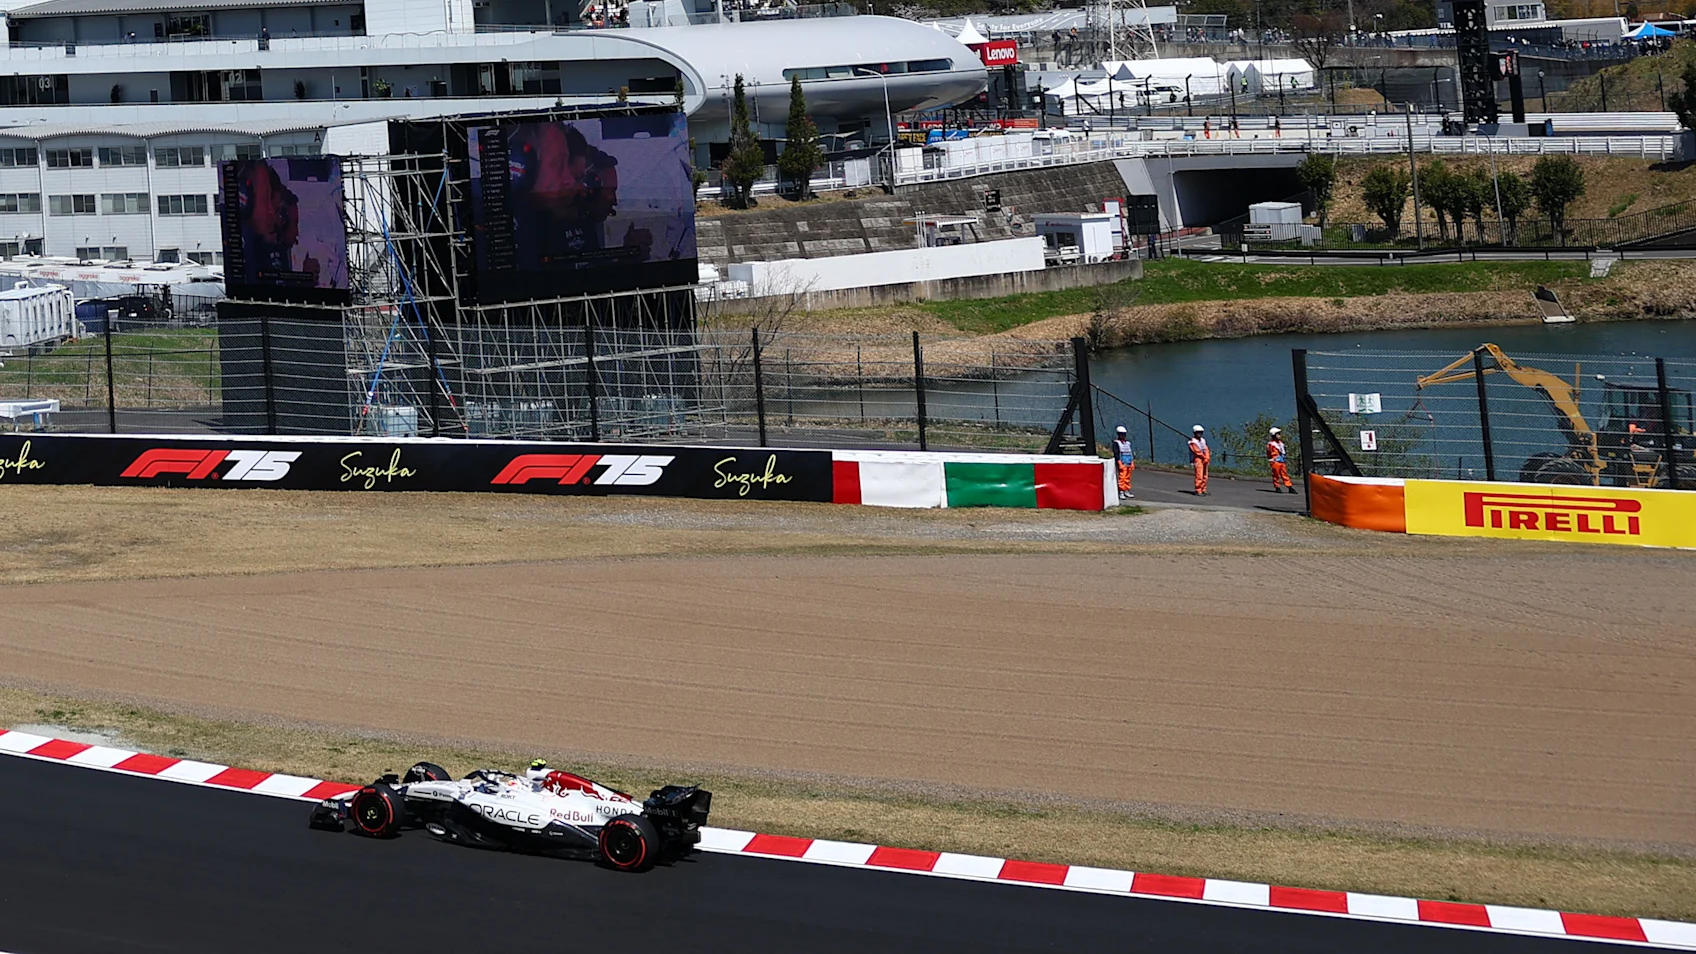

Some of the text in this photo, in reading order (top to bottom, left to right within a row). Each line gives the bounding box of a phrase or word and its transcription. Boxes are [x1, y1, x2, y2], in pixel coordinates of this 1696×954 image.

[986, 47, 1015, 60] Lenovo
[314, 132, 321, 142] A
[79, 272, 98, 280] aggreko
[340, 448, 417, 490] Suzuka
[714, 454, 793, 496] Suzuka
[1463, 491, 1642, 536] PIRELLI
[322, 800, 339, 810] Mobil
[644, 806, 669, 817] Mobil
[469, 803, 540, 826] ORACLE
[550, 808, 593, 822] Red Bull
